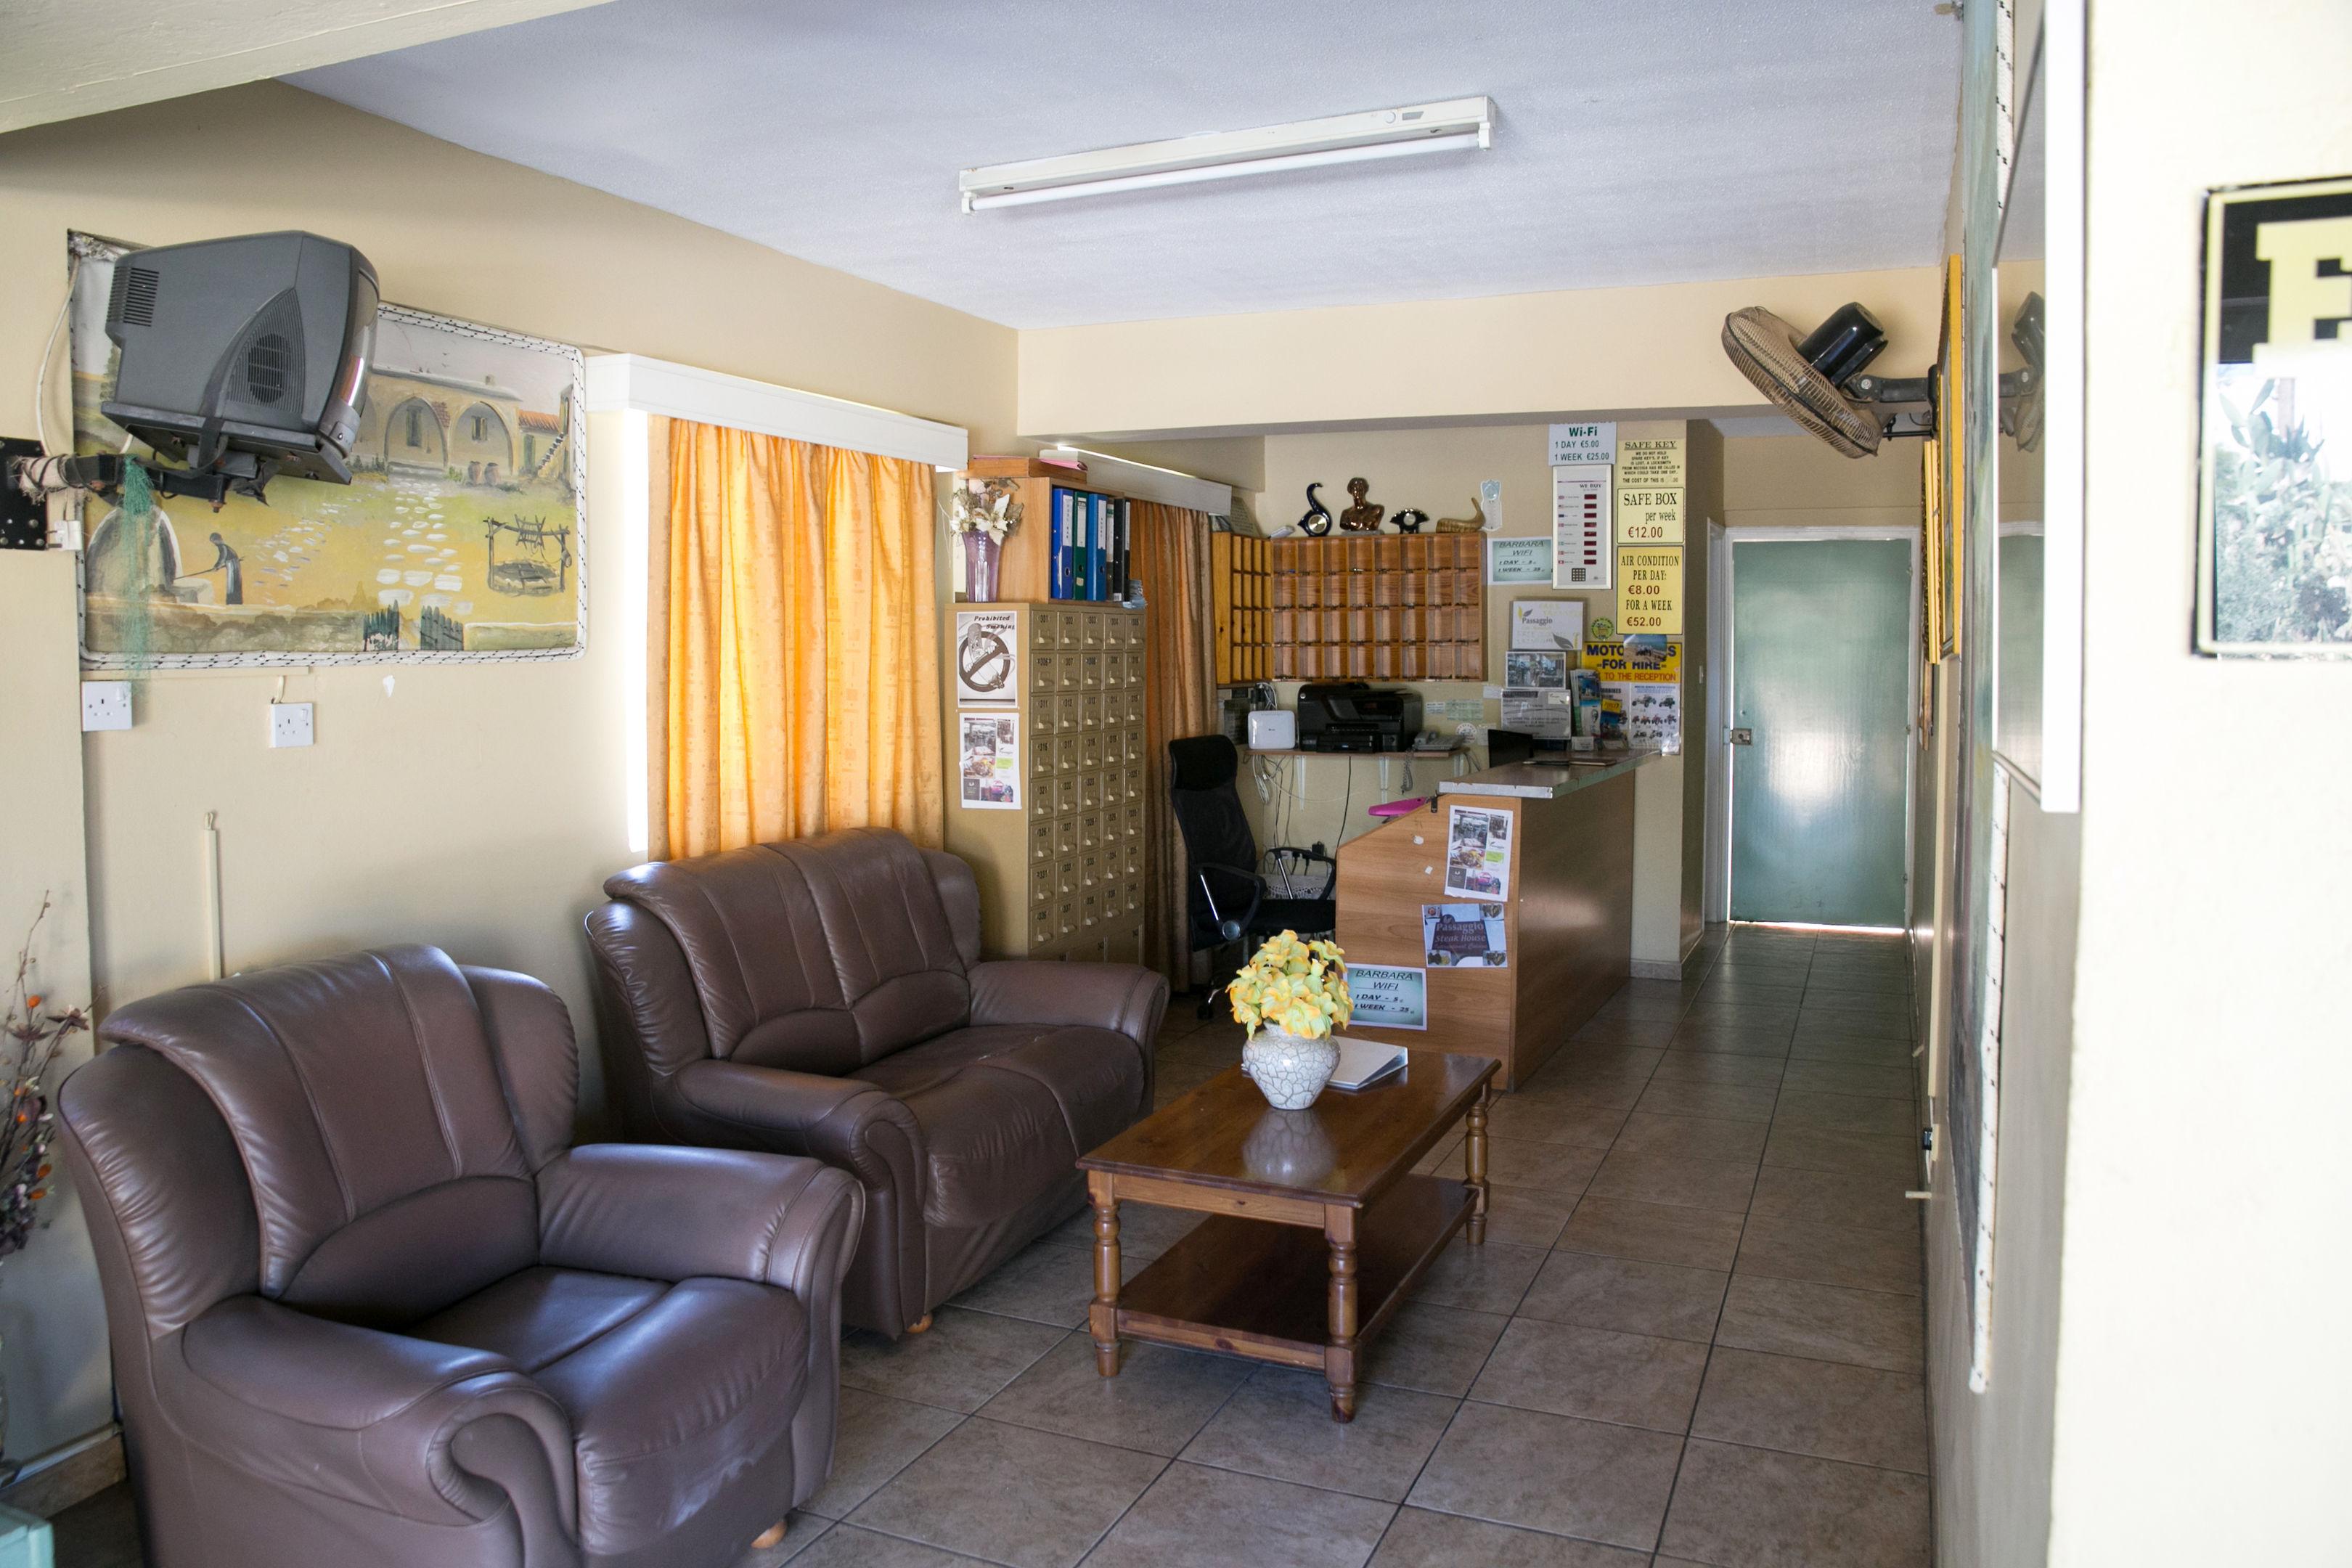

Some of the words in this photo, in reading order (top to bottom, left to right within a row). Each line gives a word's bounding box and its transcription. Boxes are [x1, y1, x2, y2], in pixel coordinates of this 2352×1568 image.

[1569, 426, 1598, 437] Wi-Fi
[1623, 493, 1651, 506] SAFE
[1655, 492, 1677, 505] BOX
[1645, 512, 1657, 524] per
[1659, 508, 1676, 521] week
[1628, 526, 1663, 538] €12.00
[1621, 555, 1634, 566] AIR
[1637, 555, 1680, 566] CONDITION
[1633, 569, 1647, 581] PER
[1628, 584, 1660, 595] €8.00
[1625, 599, 1641, 611] FOR
[1643, 600, 1648, 611] A
[1651, 600, 1673, 611] WEEK
[1522, 616, 1553, 626] Passaggio
[1627, 616, 1662, 626] €52.00
[1604, 671, 1614, 680] TO
[1617, 671, 1632, 680] THE
[1634, 671, 1676, 681] RECEPTION
[1436, 921, 1485, 934] Passaggio
[1355, 970, 1413, 980] BARBARA
[1373, 981, 1399, 990] WIFI
